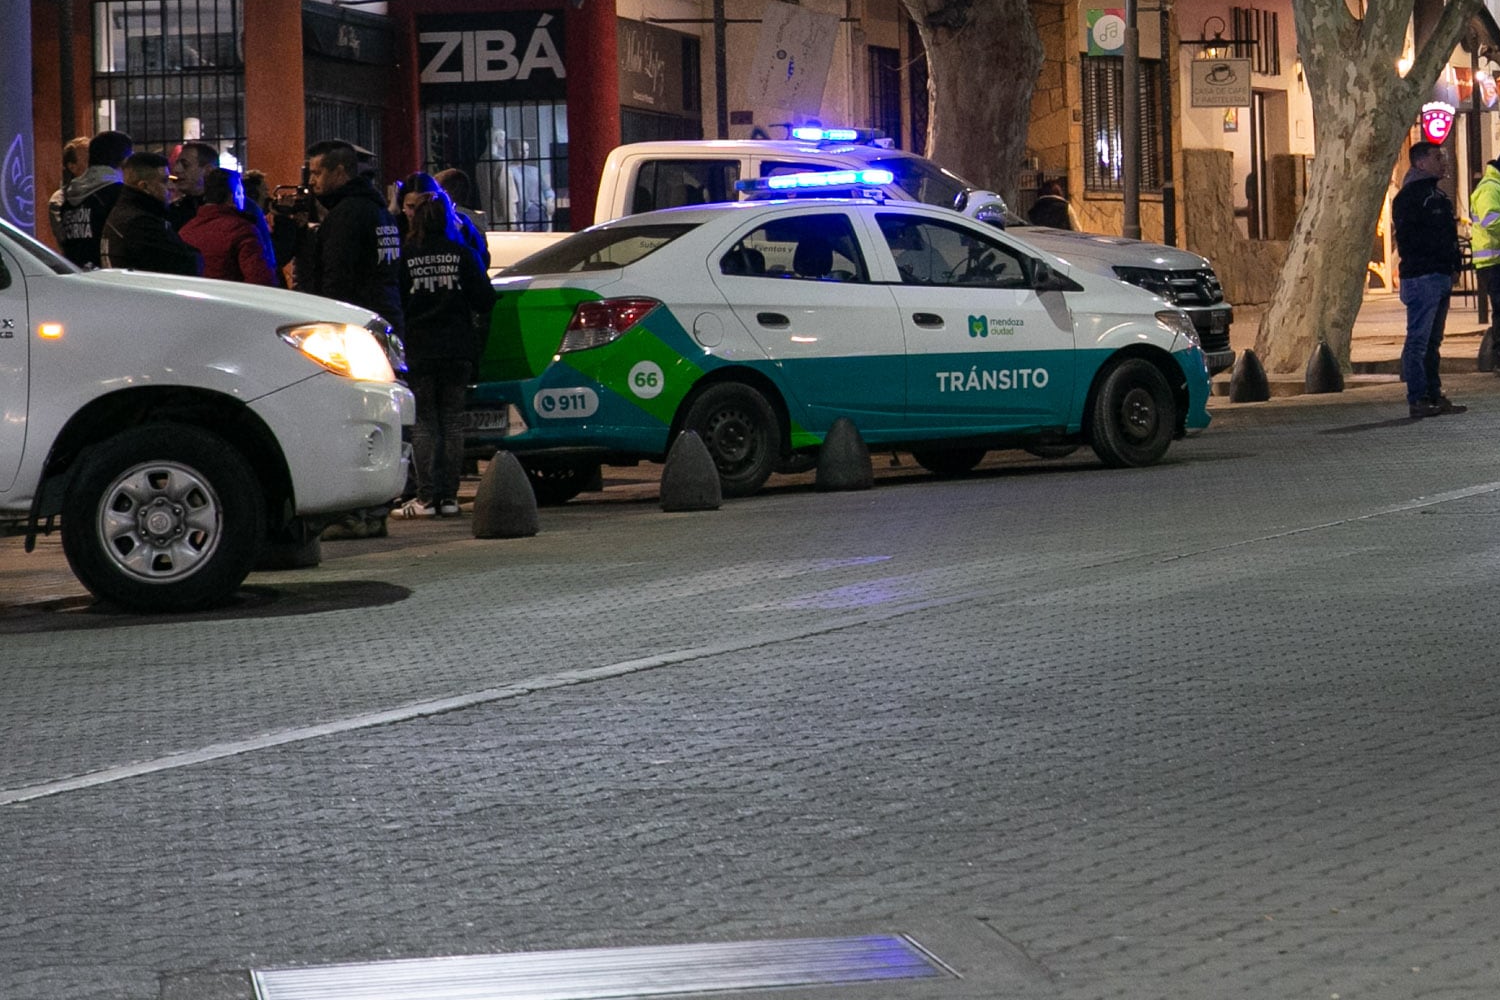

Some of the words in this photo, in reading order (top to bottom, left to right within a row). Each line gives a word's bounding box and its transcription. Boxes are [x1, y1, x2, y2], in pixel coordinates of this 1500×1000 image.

[419, 13, 567, 83] ZIBÁ
[407, 253, 460, 268] DIVERSIÓN
[991, 318, 1024, 327] mendoza
[991, 327, 1014, 335] ciudad
[634, 372, 658, 387] 66
[936, 365, 1049, 392] TRÁNSITO
[559, 394, 586, 411] 911
